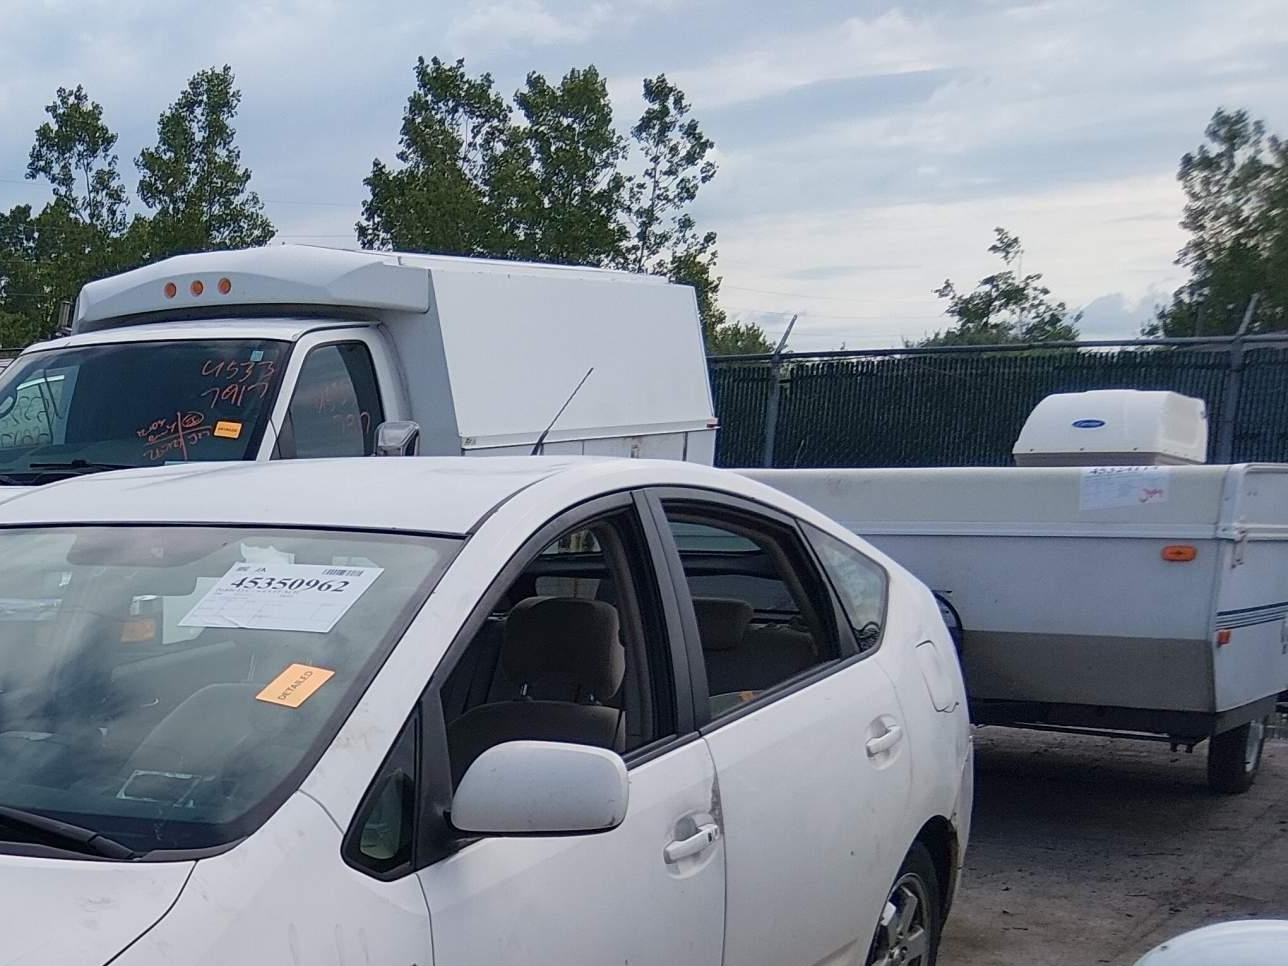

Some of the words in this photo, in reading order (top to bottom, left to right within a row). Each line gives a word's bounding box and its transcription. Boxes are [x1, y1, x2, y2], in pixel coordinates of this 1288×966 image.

[201, 359, 276, 383] 4533
[200, 382, 269, 409] 7917
[231, 576, 350, 593] 45350962
